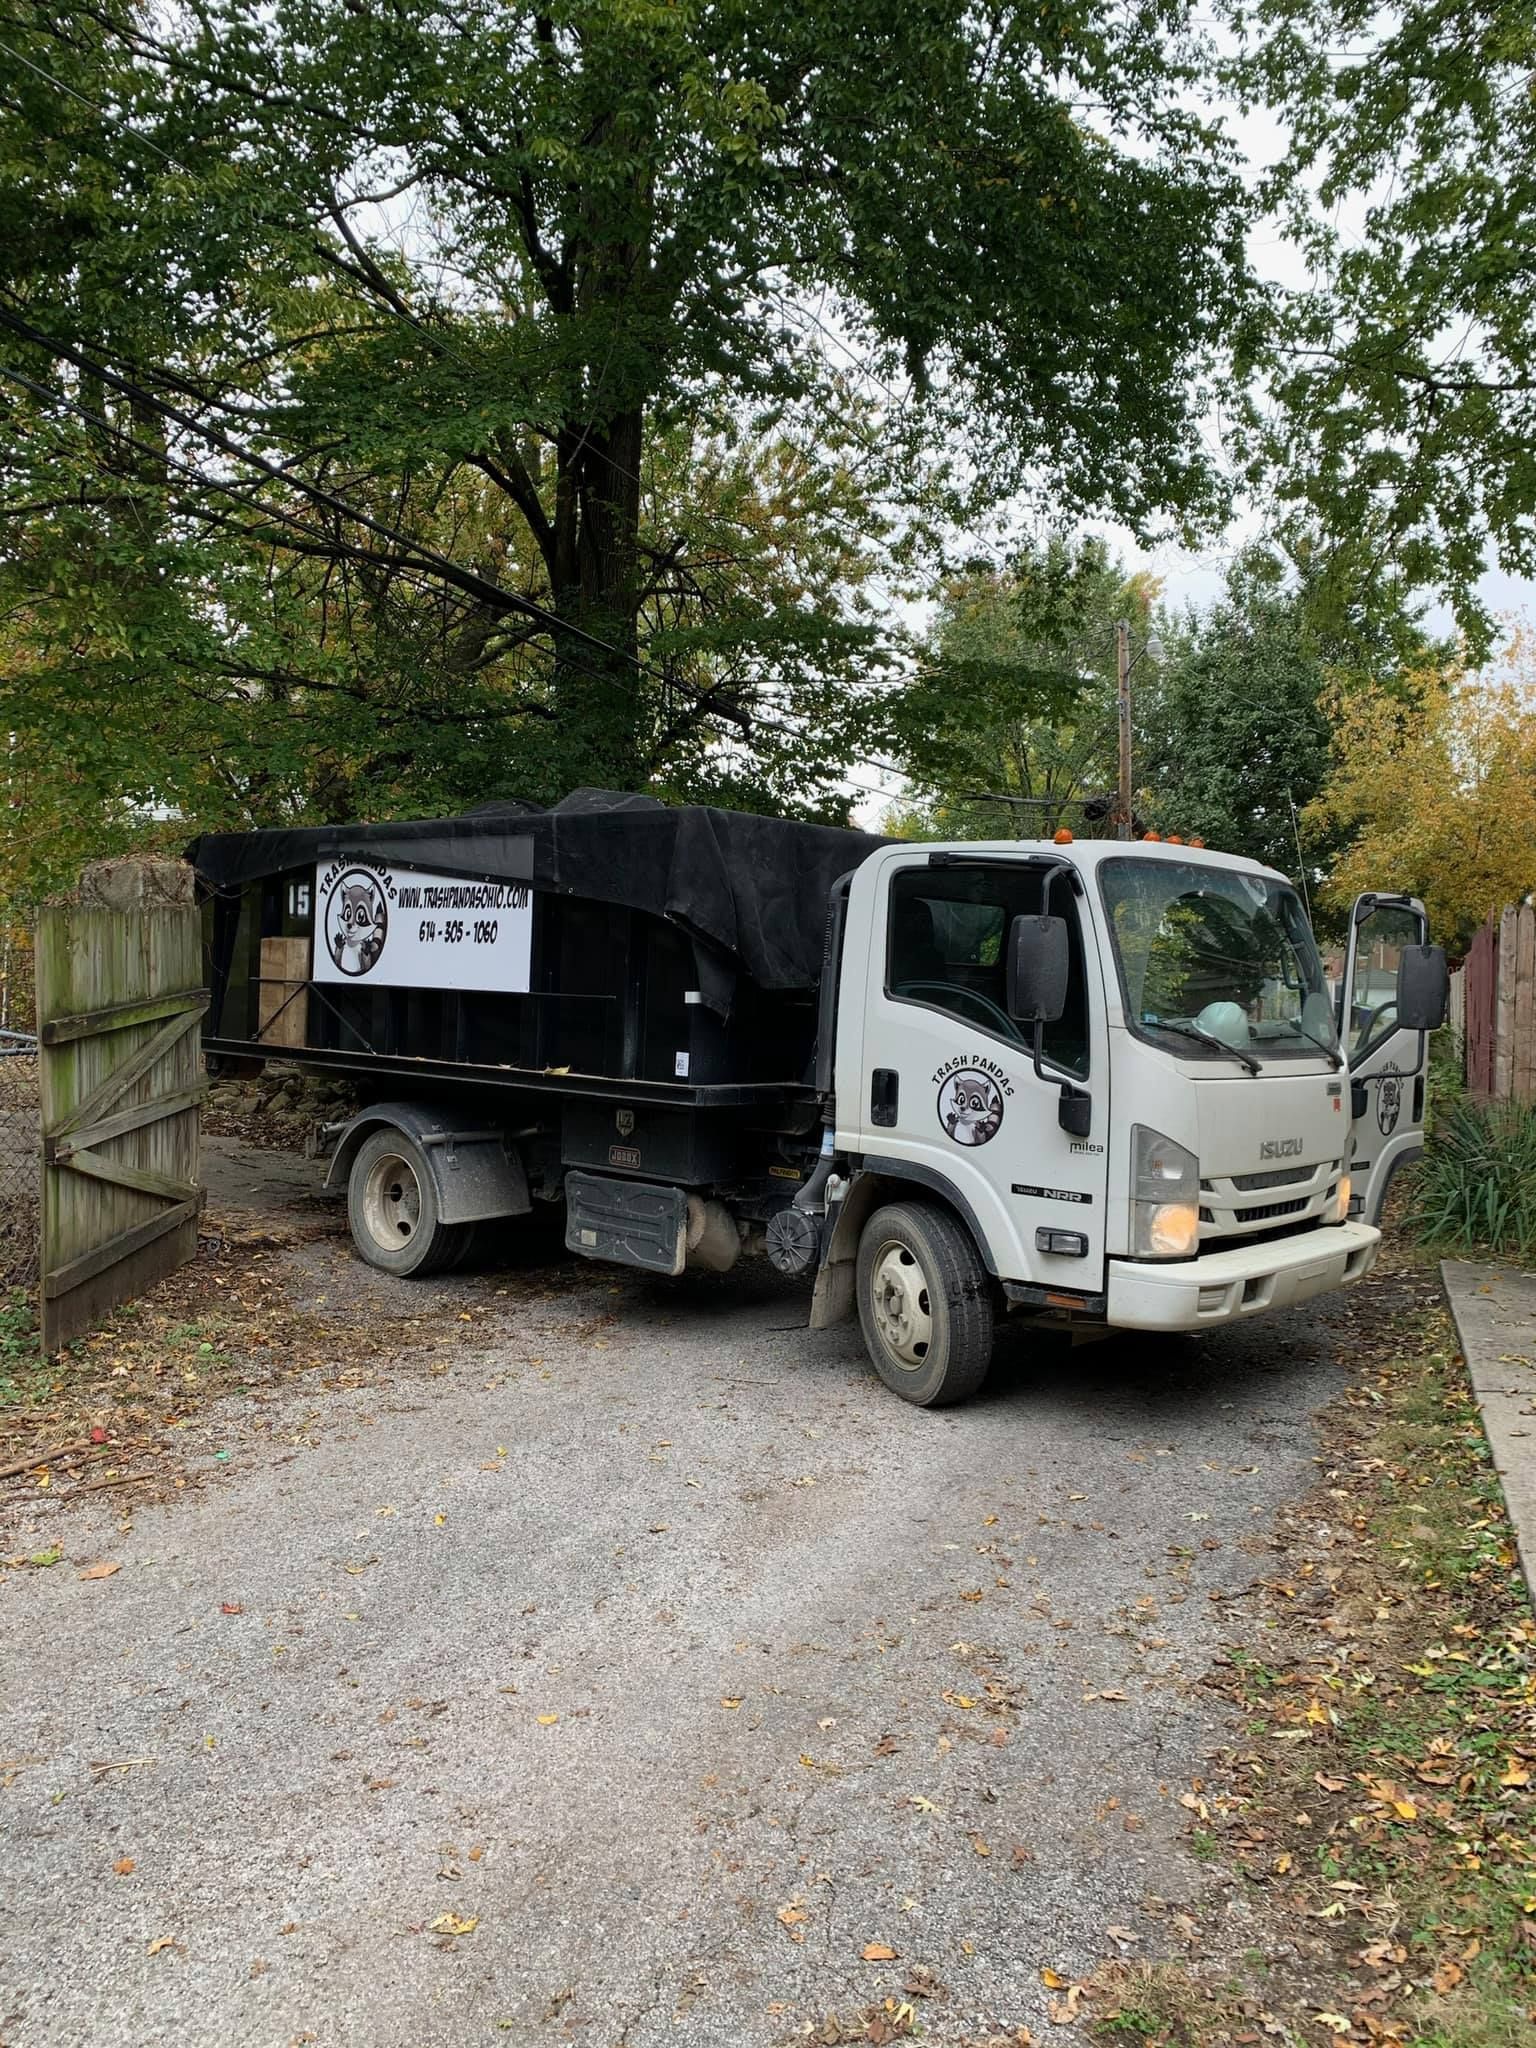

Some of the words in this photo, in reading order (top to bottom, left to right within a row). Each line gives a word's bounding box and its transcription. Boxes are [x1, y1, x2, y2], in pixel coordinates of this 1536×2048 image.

[288, 884, 310, 916] 15
[398, 885, 528, 910] WWW.TRASHPANDASOHIO.COM
[419, 920, 436, 942] 614
[473, 920, 498, 944] 1060
[931, 1055, 968, 1085] TRASH
[972, 1055, 1015, 1097] PANDAS
[1069, 1141, 1104, 1153] milea
[1260, 1137, 1303, 1160] ISUZU
[1043, 1189, 1082, 1202] NRR
